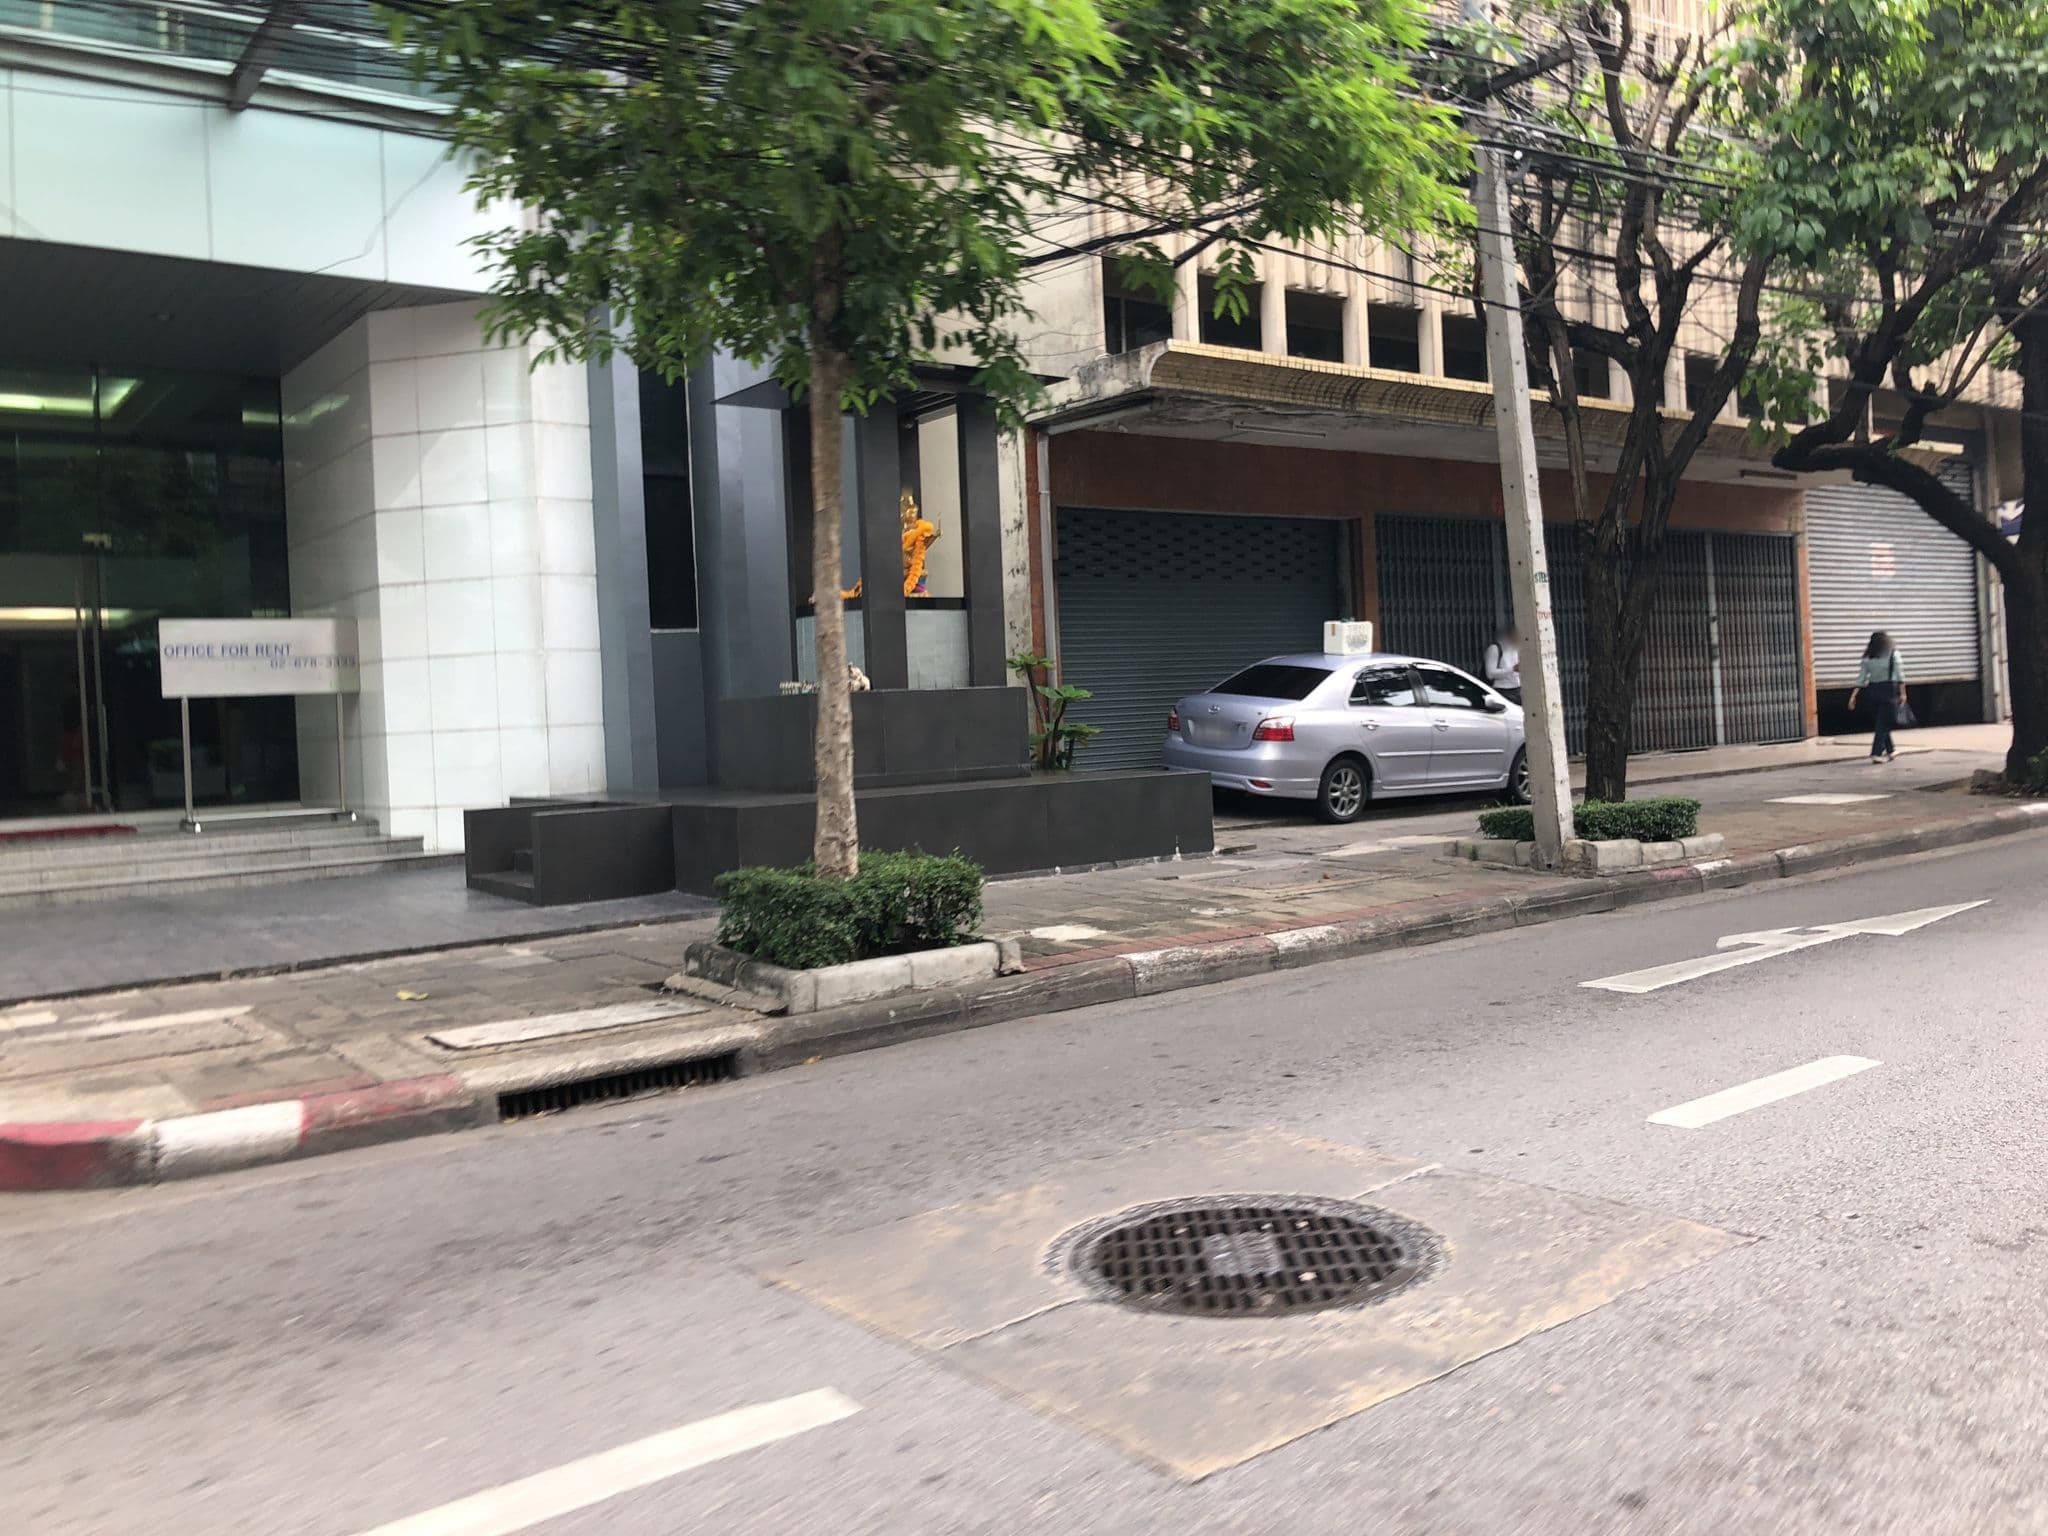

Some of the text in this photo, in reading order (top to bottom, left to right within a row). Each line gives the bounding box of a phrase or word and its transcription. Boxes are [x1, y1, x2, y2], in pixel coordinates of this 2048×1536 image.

[164, 642, 291, 658] OFFICE FOR RENT
